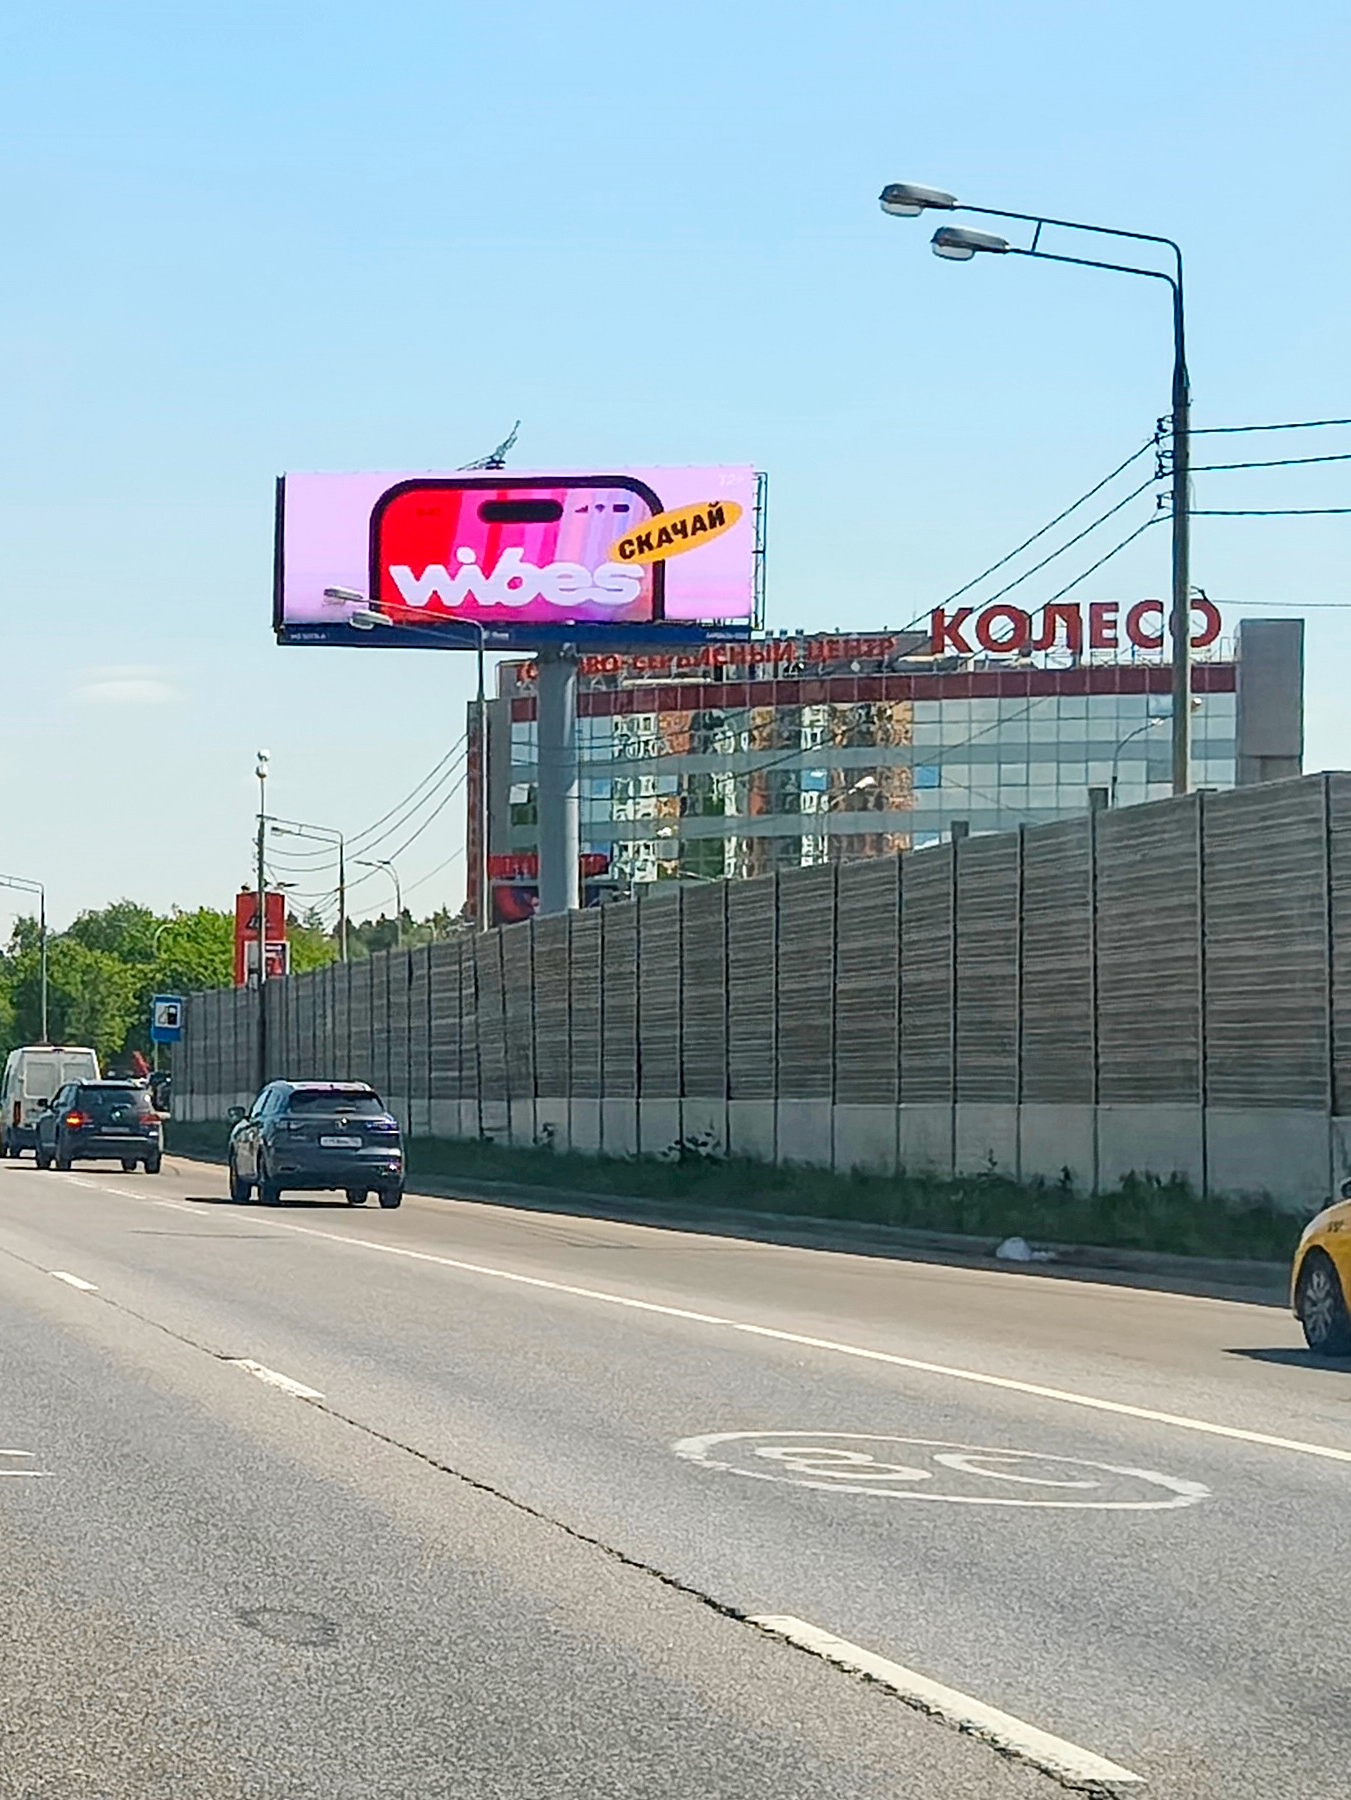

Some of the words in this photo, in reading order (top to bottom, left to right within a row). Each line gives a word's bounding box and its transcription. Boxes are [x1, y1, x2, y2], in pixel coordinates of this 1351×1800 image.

[619, 501, 726, 560] СКАЧАЙ
[389, 546, 645, 607] wibes
[931, 599, 1222, 654] КОЛЕСО
